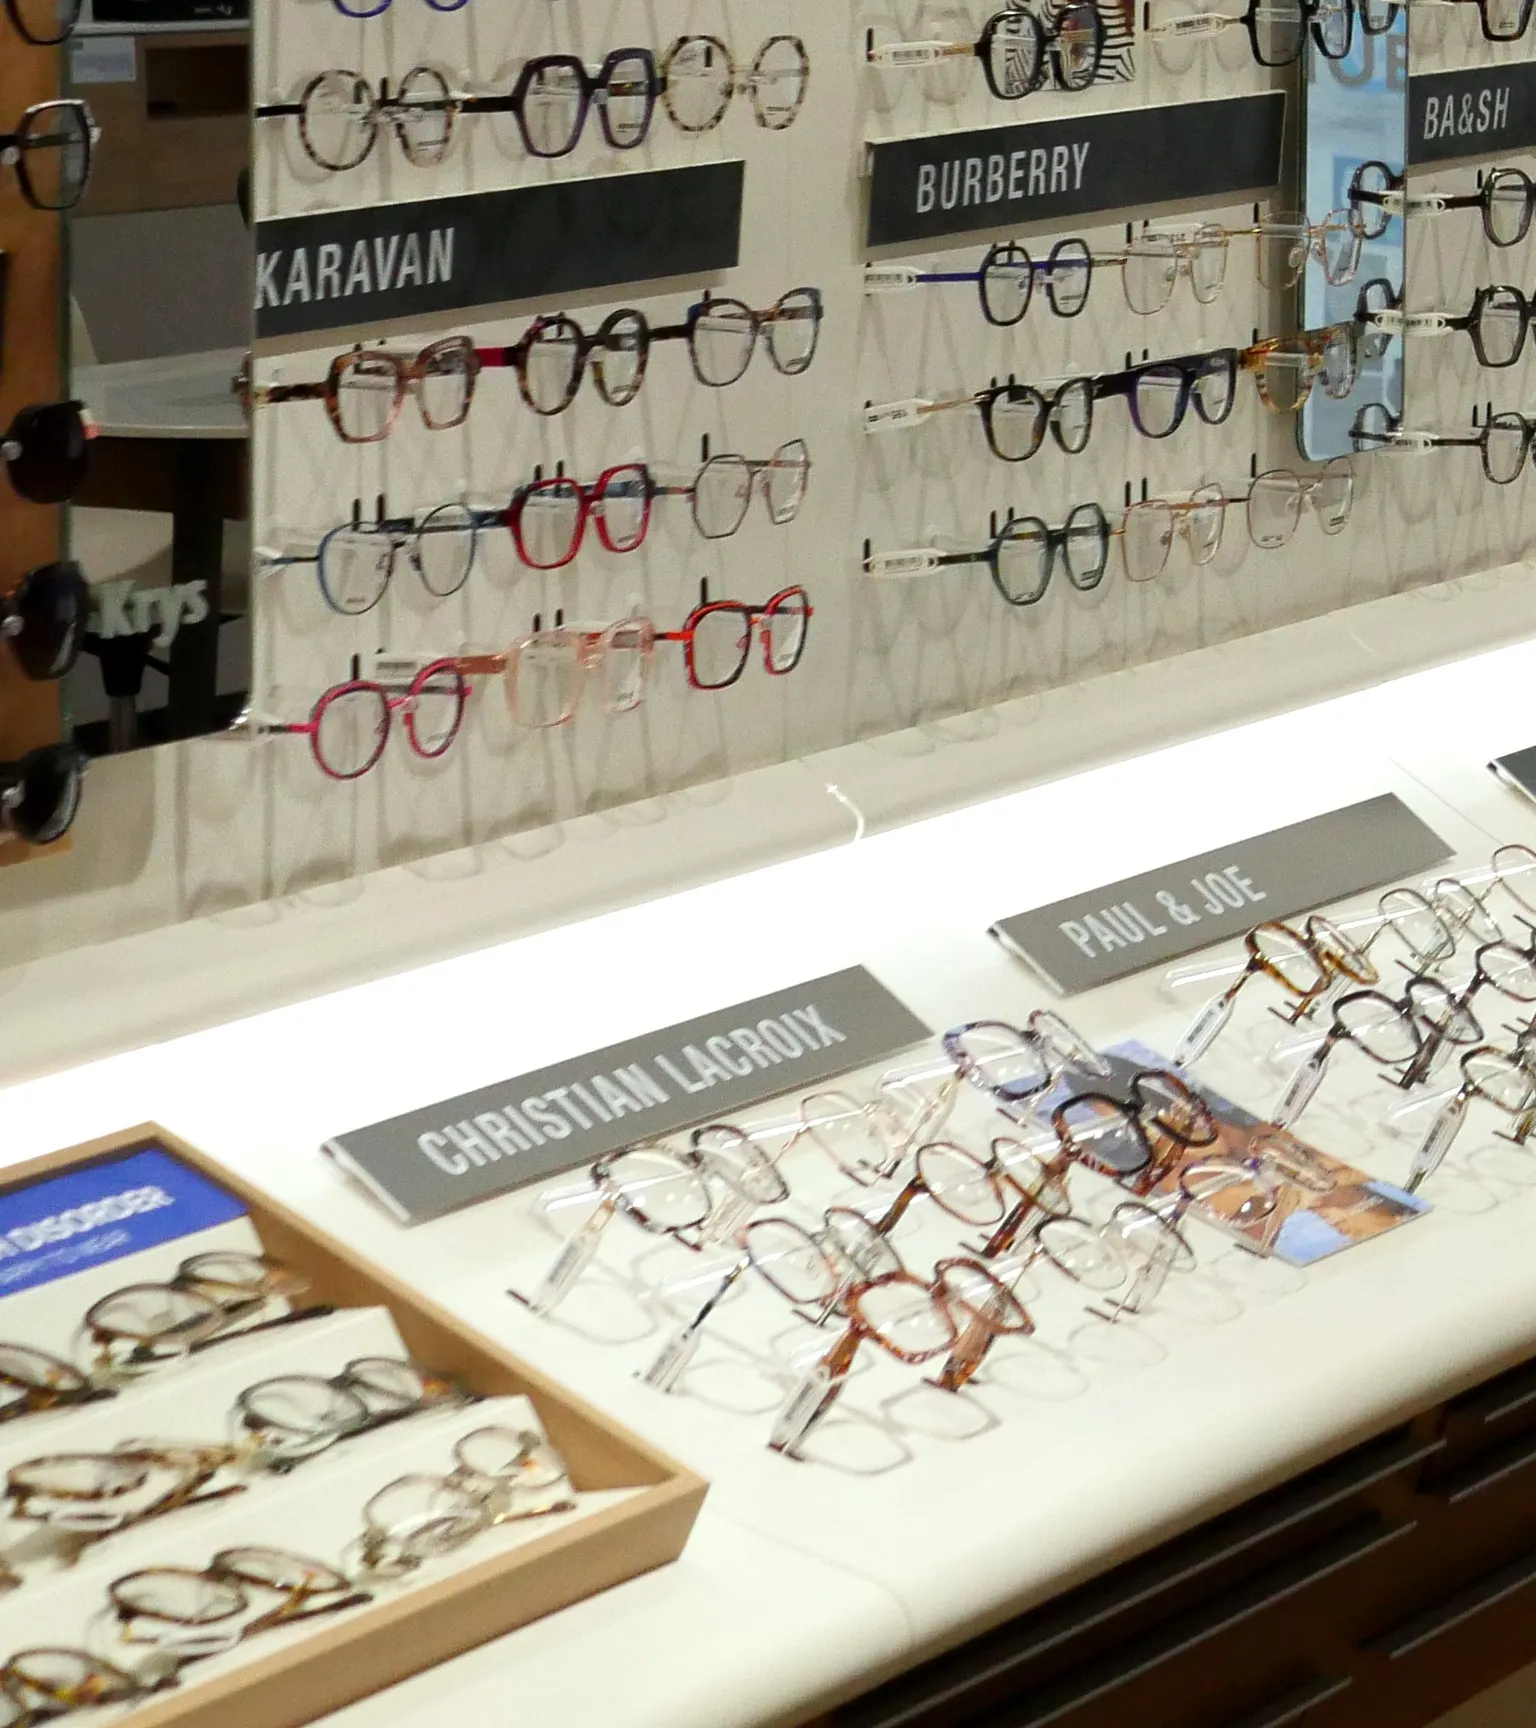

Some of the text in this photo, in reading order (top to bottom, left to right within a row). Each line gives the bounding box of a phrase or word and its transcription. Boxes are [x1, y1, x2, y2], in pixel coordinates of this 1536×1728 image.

[1423, 86, 1510, 140] BA&SH
[915, 141, 1091, 214] BURBERRY
[254, 226, 456, 311] KARAVAN
[1057, 864, 1268, 959] PAUL & JOE
[416, 1003, 848, 1176] CHRISTIAN LACROIX
